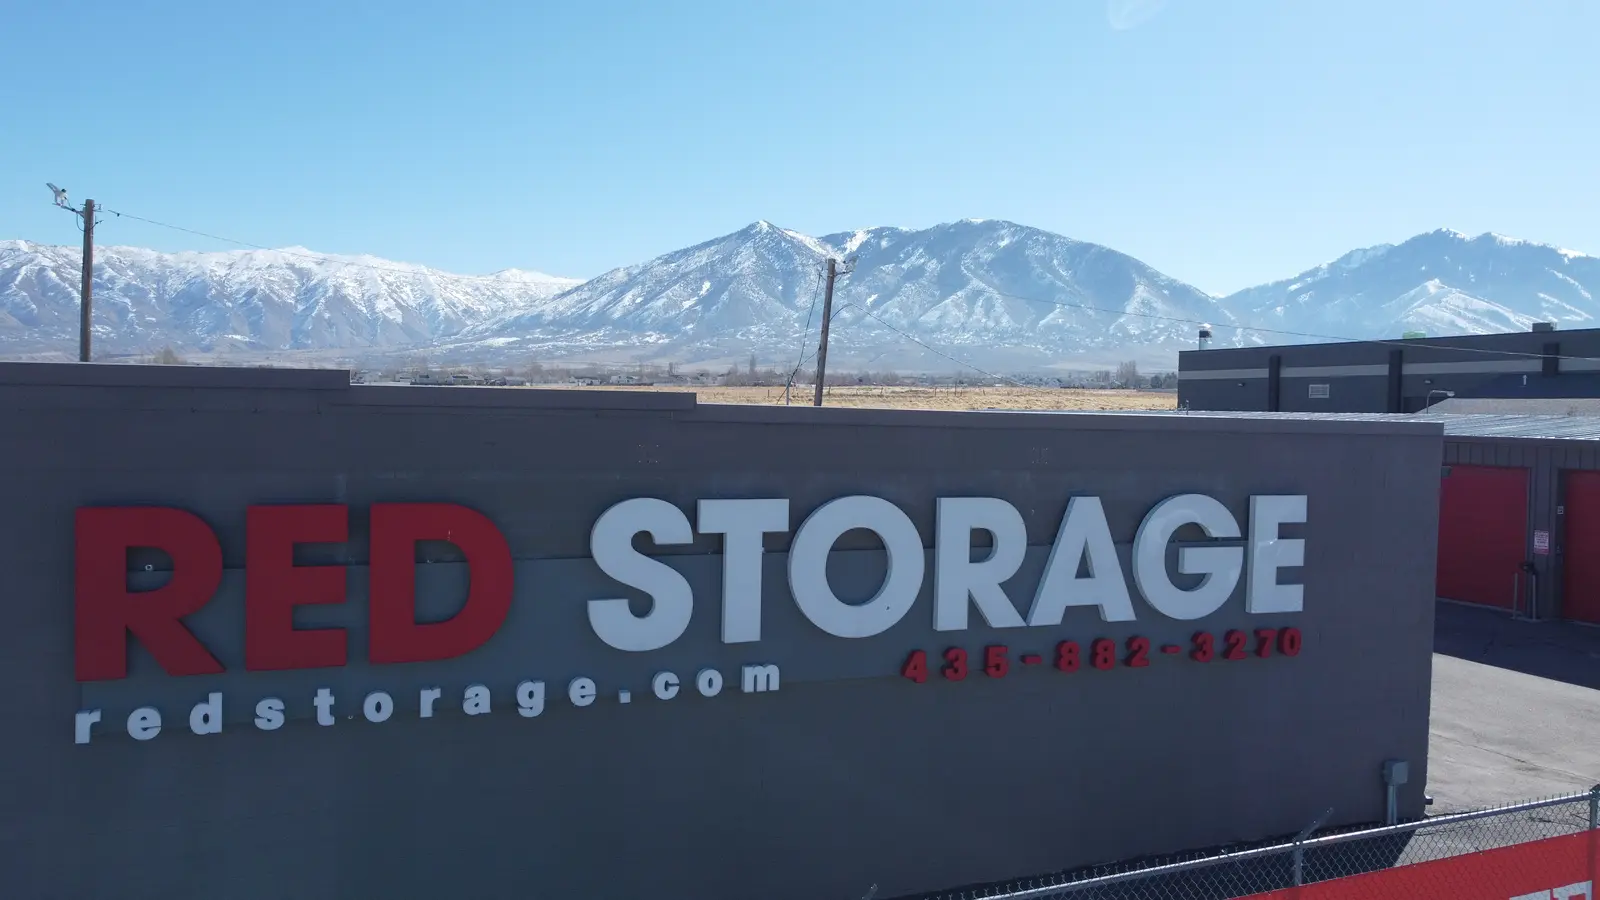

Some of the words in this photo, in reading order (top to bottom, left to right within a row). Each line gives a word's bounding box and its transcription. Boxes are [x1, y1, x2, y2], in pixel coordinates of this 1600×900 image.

[74, 503, 514, 682] RED
[587, 494, 1308, 652] STORAGE
[903, 626, 1302, 684] 435-882-3270
[74, 662, 781, 744] redstorage.com
